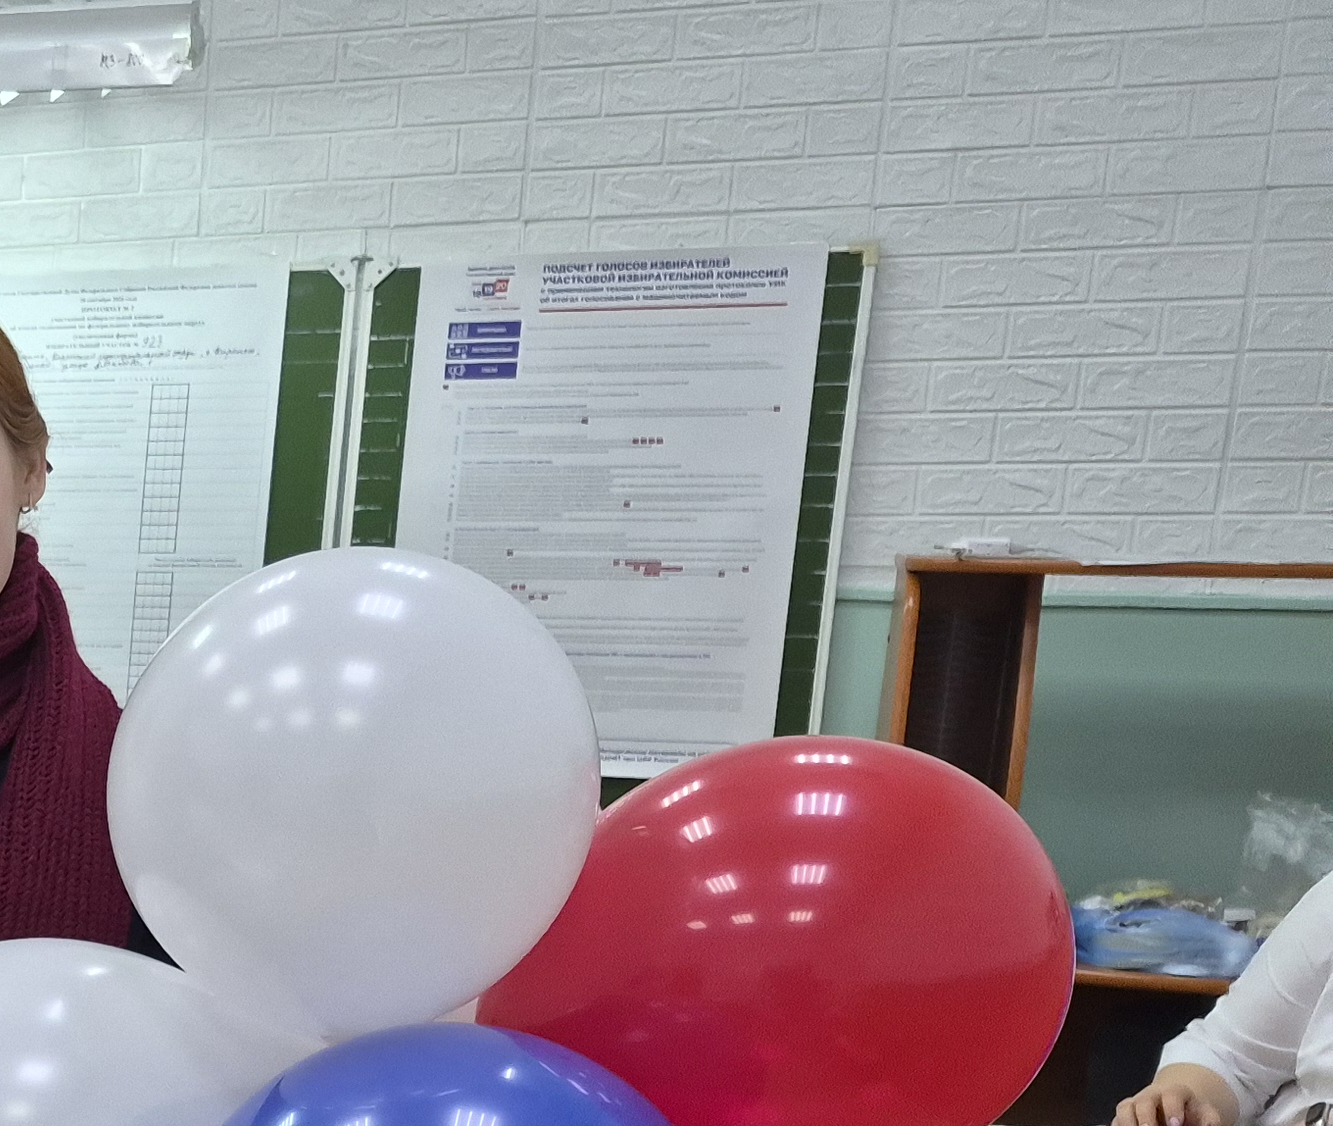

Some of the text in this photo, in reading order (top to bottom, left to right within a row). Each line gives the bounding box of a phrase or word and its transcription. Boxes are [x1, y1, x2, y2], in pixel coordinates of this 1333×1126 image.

[543, 257, 730, 274] ПОДСЧЕТ ГОЛОСОВ ИЗБИРАТЕЛЕЙ
[542, 267, 788, 285] УЧАСТКОВОЙ ИЗБИРАТЕЛЬНОЙ КОМИССИЕЙ
